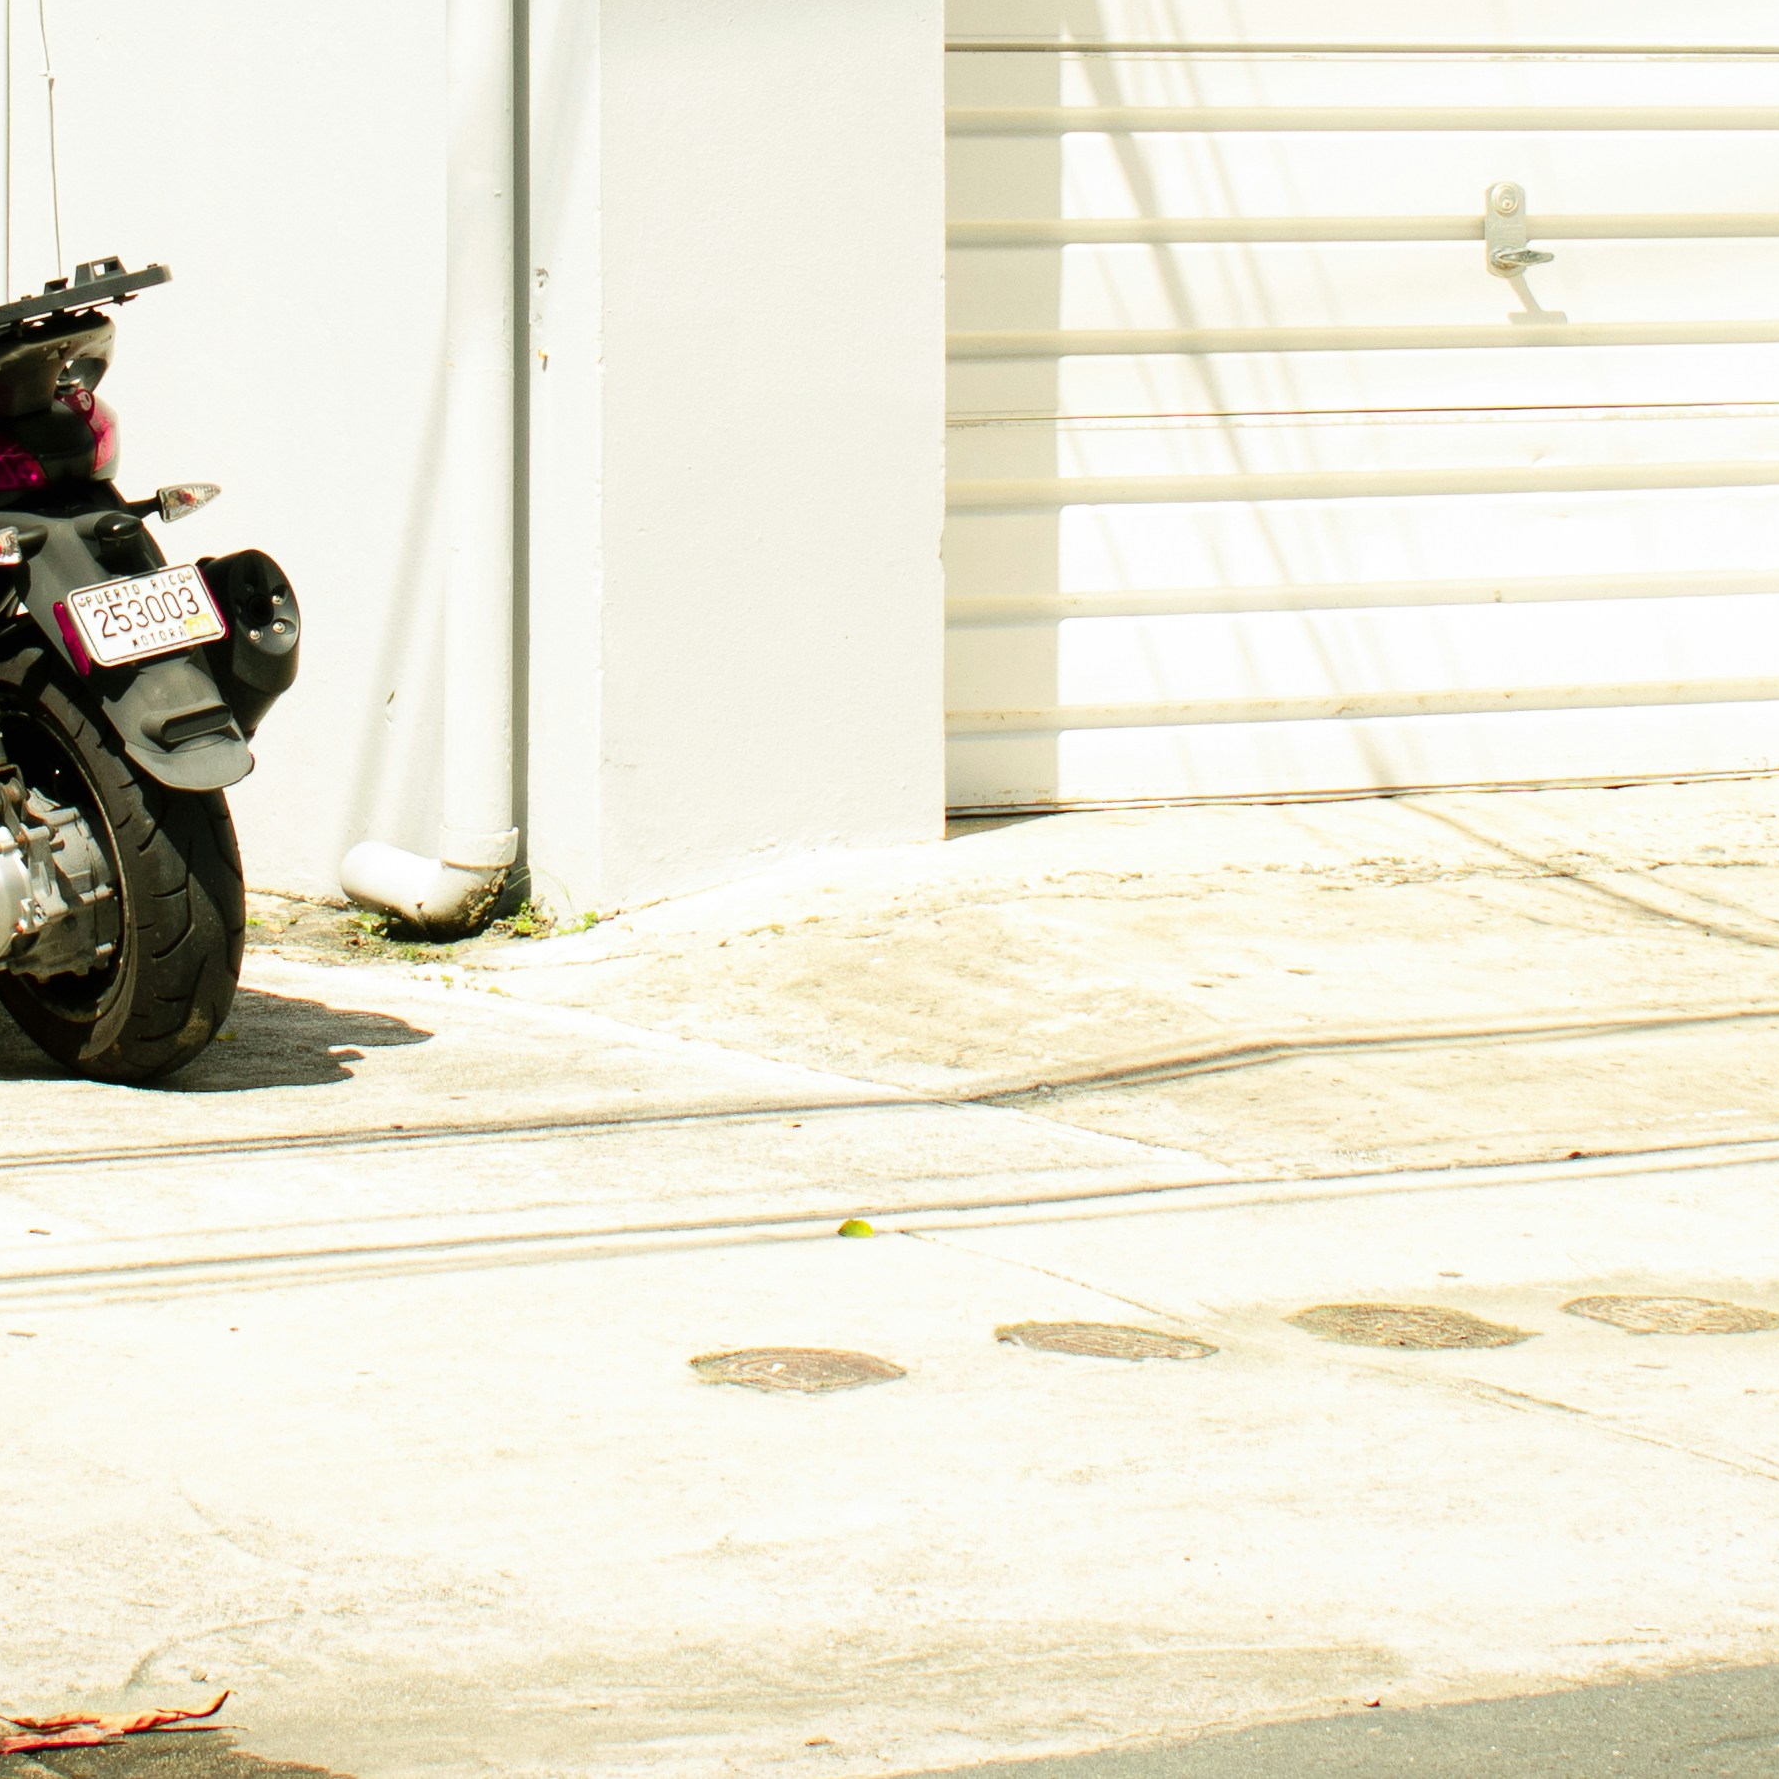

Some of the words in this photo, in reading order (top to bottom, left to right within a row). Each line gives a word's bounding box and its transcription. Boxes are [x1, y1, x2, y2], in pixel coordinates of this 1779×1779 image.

[85, 583, 141, 608] PUERTO
[150, 572, 186, 590] RICO
[93, 586, 200, 639] 253003
[132, 625, 187, 649] MOTORA
